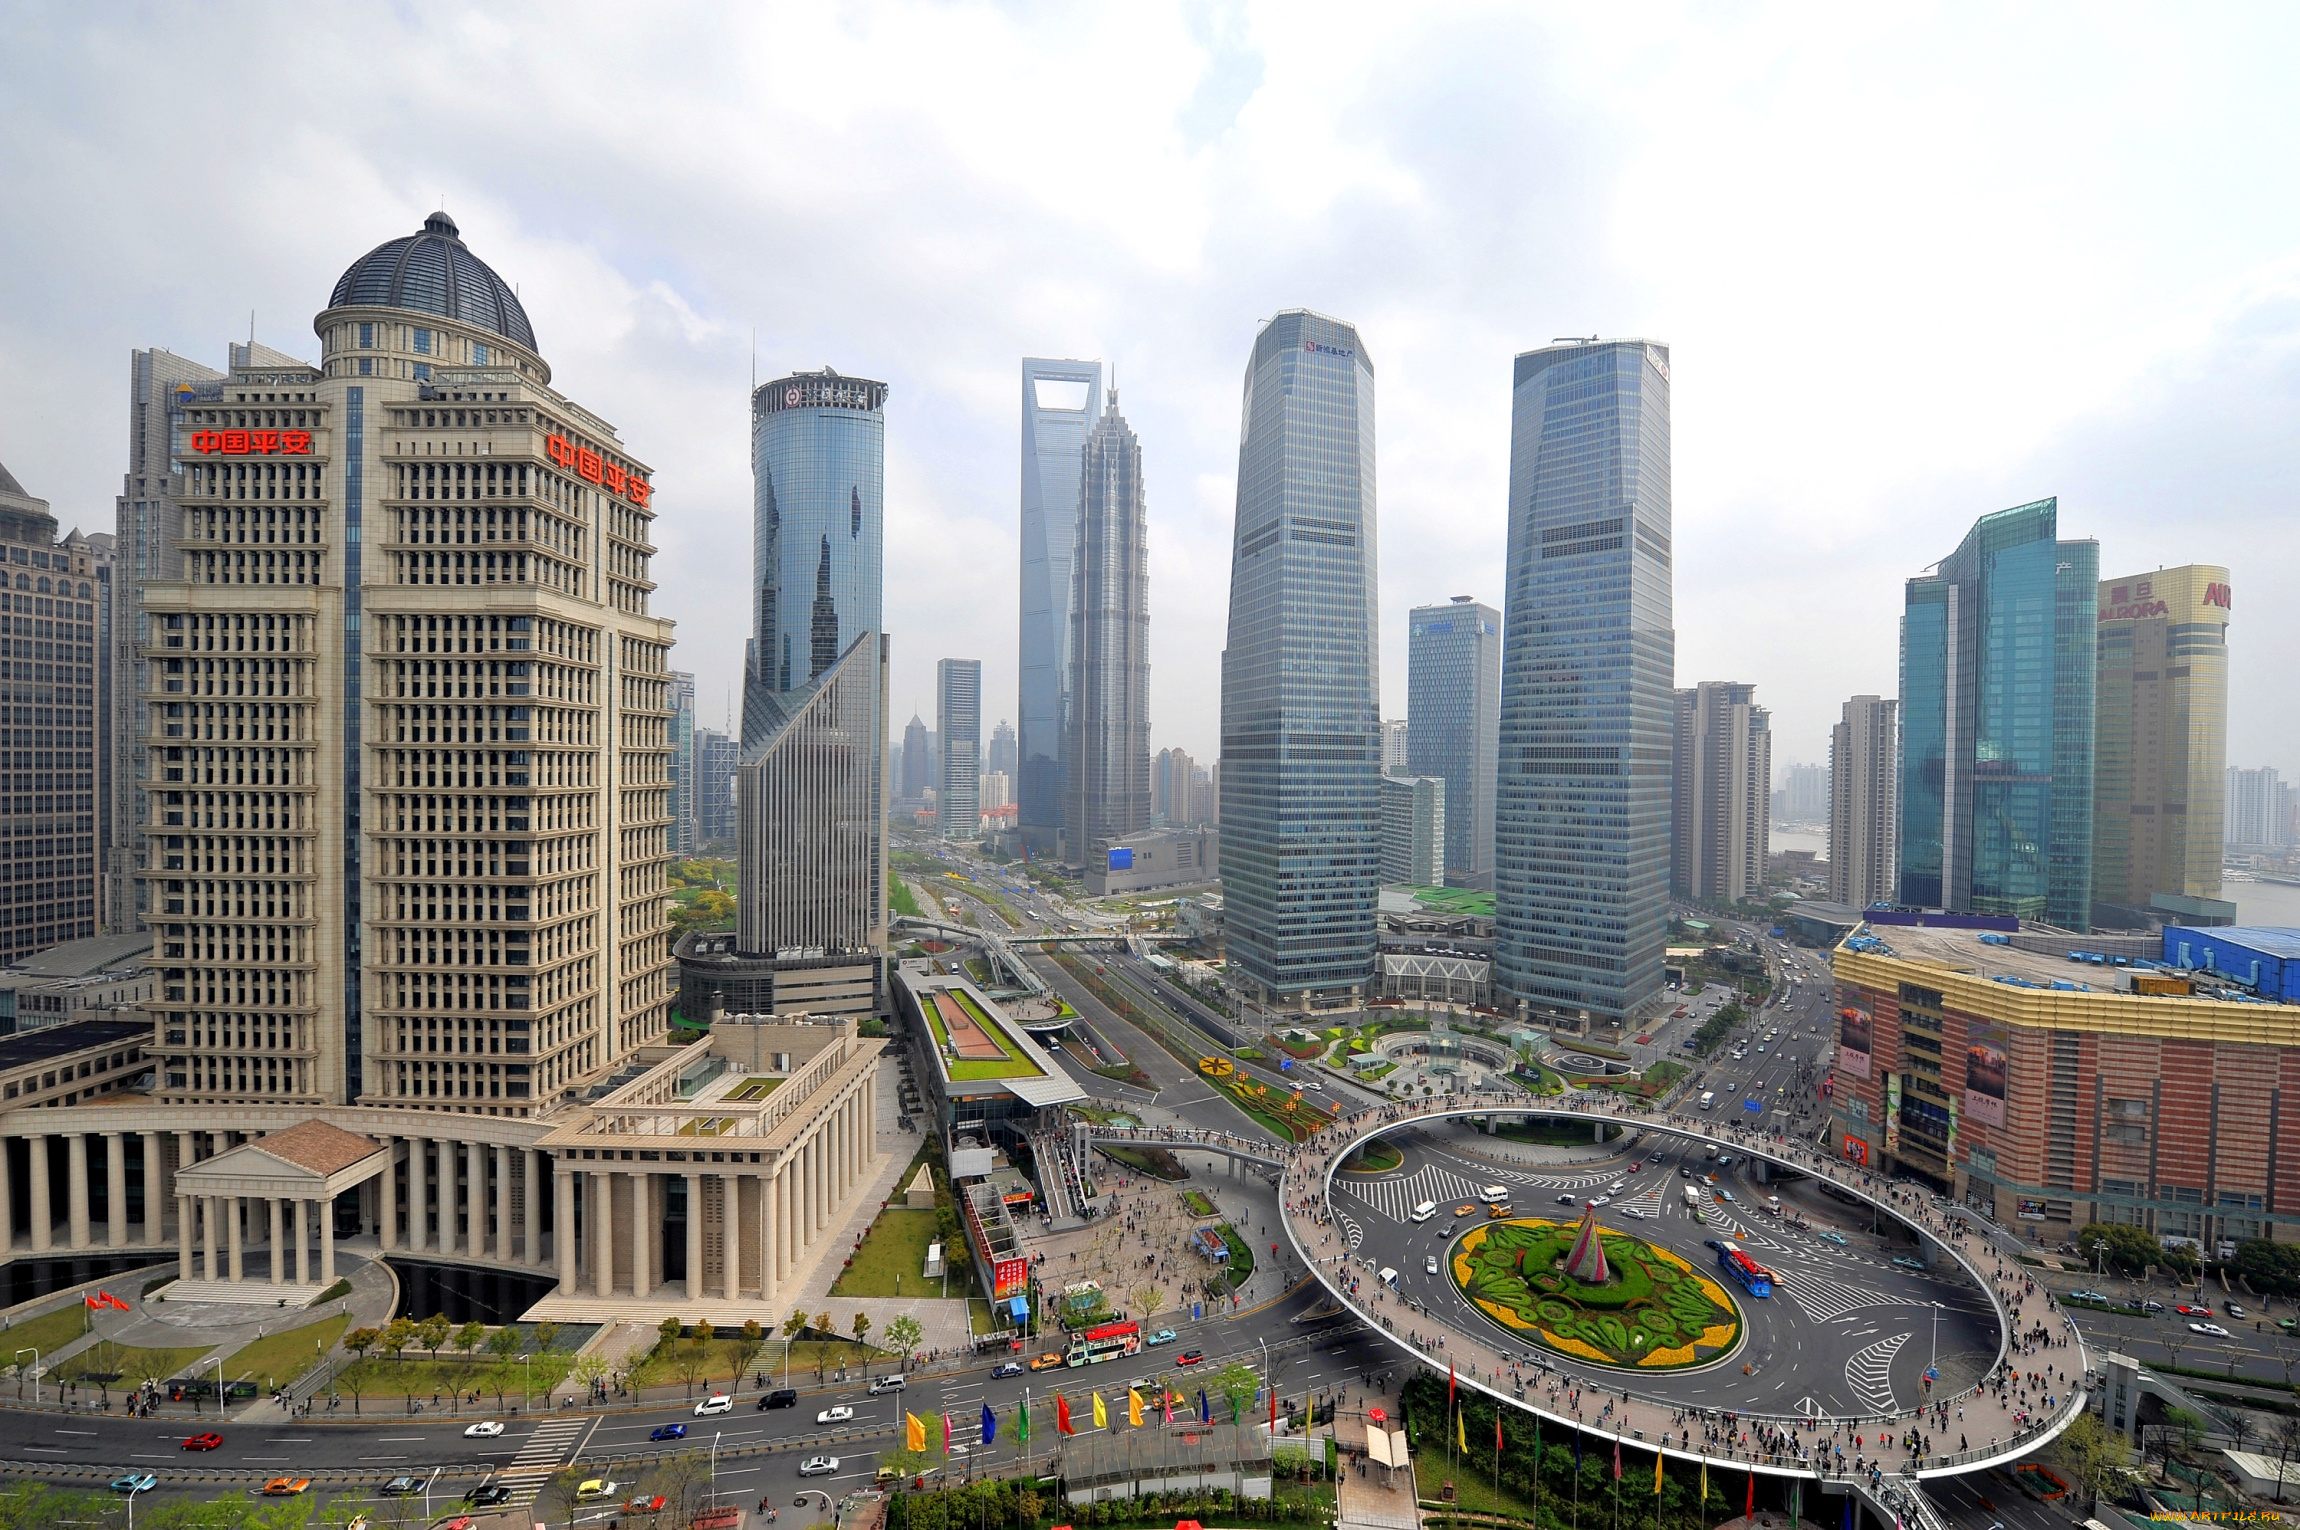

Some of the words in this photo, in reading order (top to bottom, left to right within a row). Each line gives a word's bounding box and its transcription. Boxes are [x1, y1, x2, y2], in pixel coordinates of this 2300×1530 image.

[192, 429, 311, 455] 中国平安
[547, 433, 651, 508] 中国平安
[2098, 600, 2169, 622] AURORA
[2020, 1200, 2043, 1208] Super
